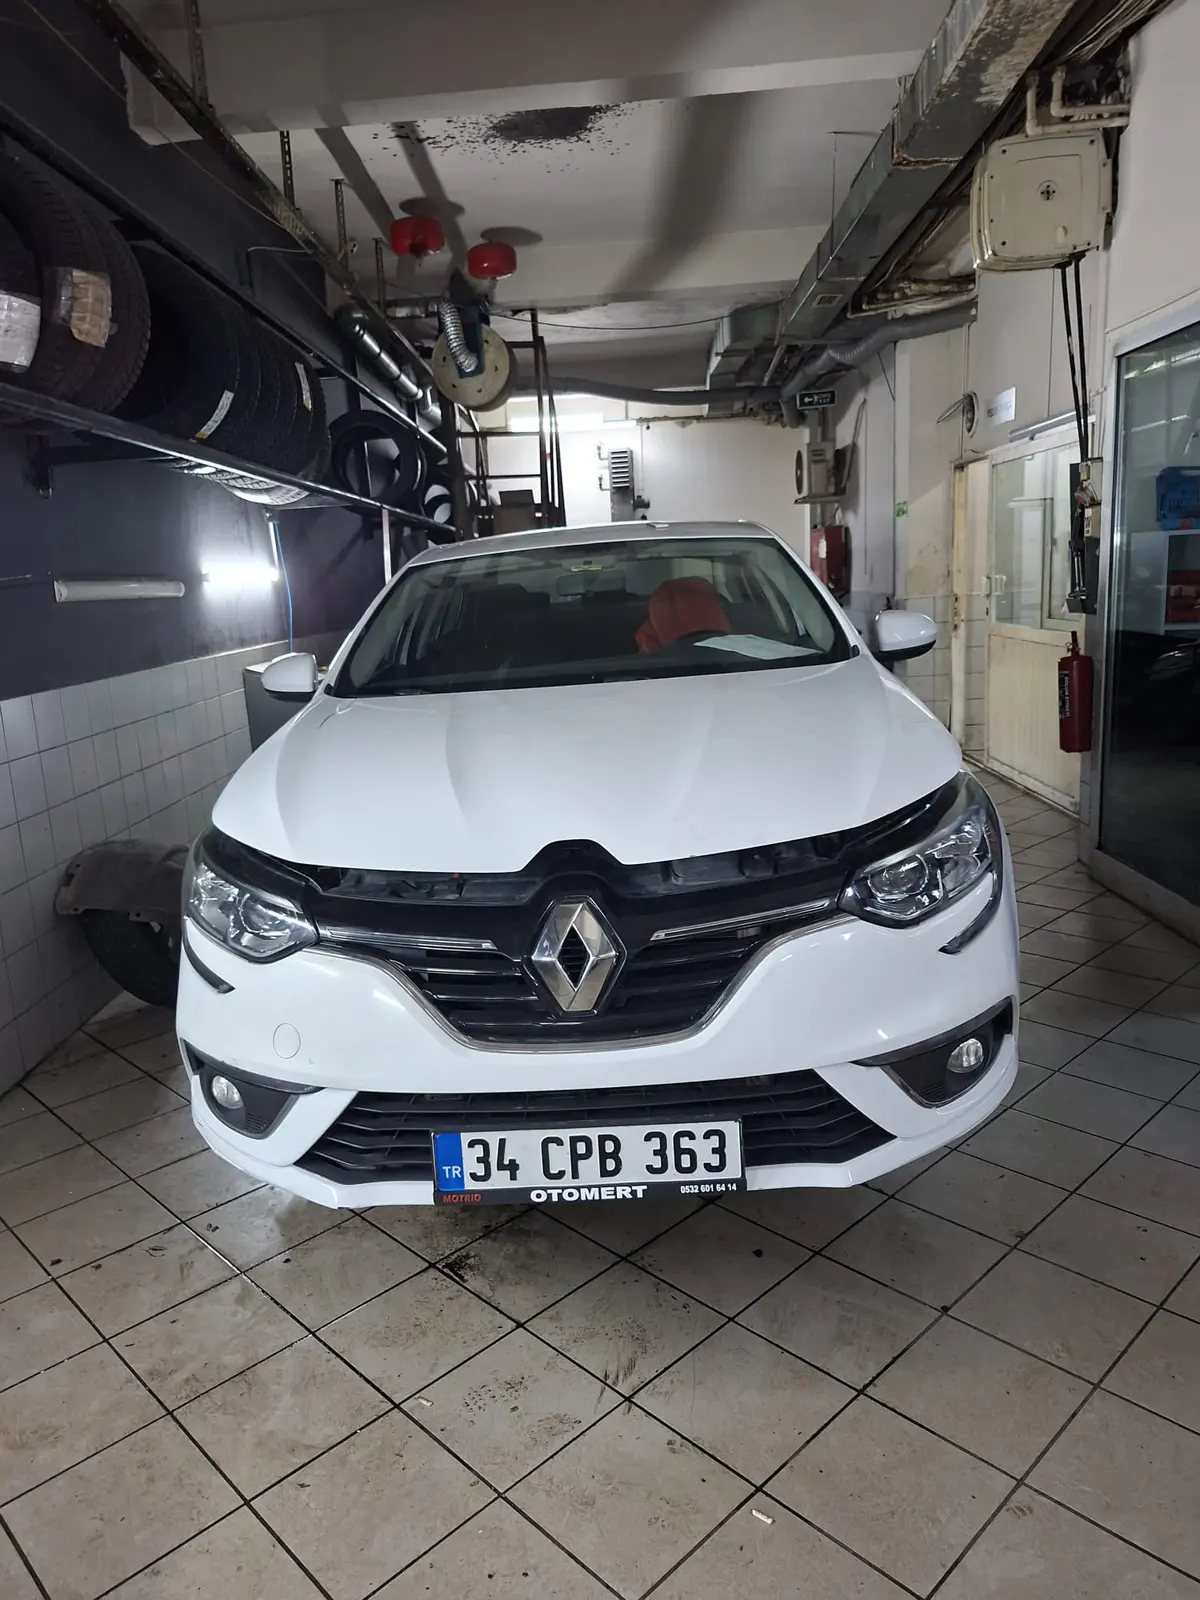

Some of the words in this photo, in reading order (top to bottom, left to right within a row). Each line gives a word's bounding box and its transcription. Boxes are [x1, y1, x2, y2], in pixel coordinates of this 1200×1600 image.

[468, 1138, 520, 1182] 34
[541, 1134, 623, 1180] CPB
[643, 1129, 727, 1175] 363
[442, 1165, 462, 1179] TR
[530, 1186, 648, 1203] OTOMERT
[680, 1185, 699, 1194] 0532
[700, 1184, 714, 1193] 601
[716, 1183, 726, 1192] 64
[727, 1183, 737, 1191] 14
[442, 1193, 482, 1203] MOTRIO
